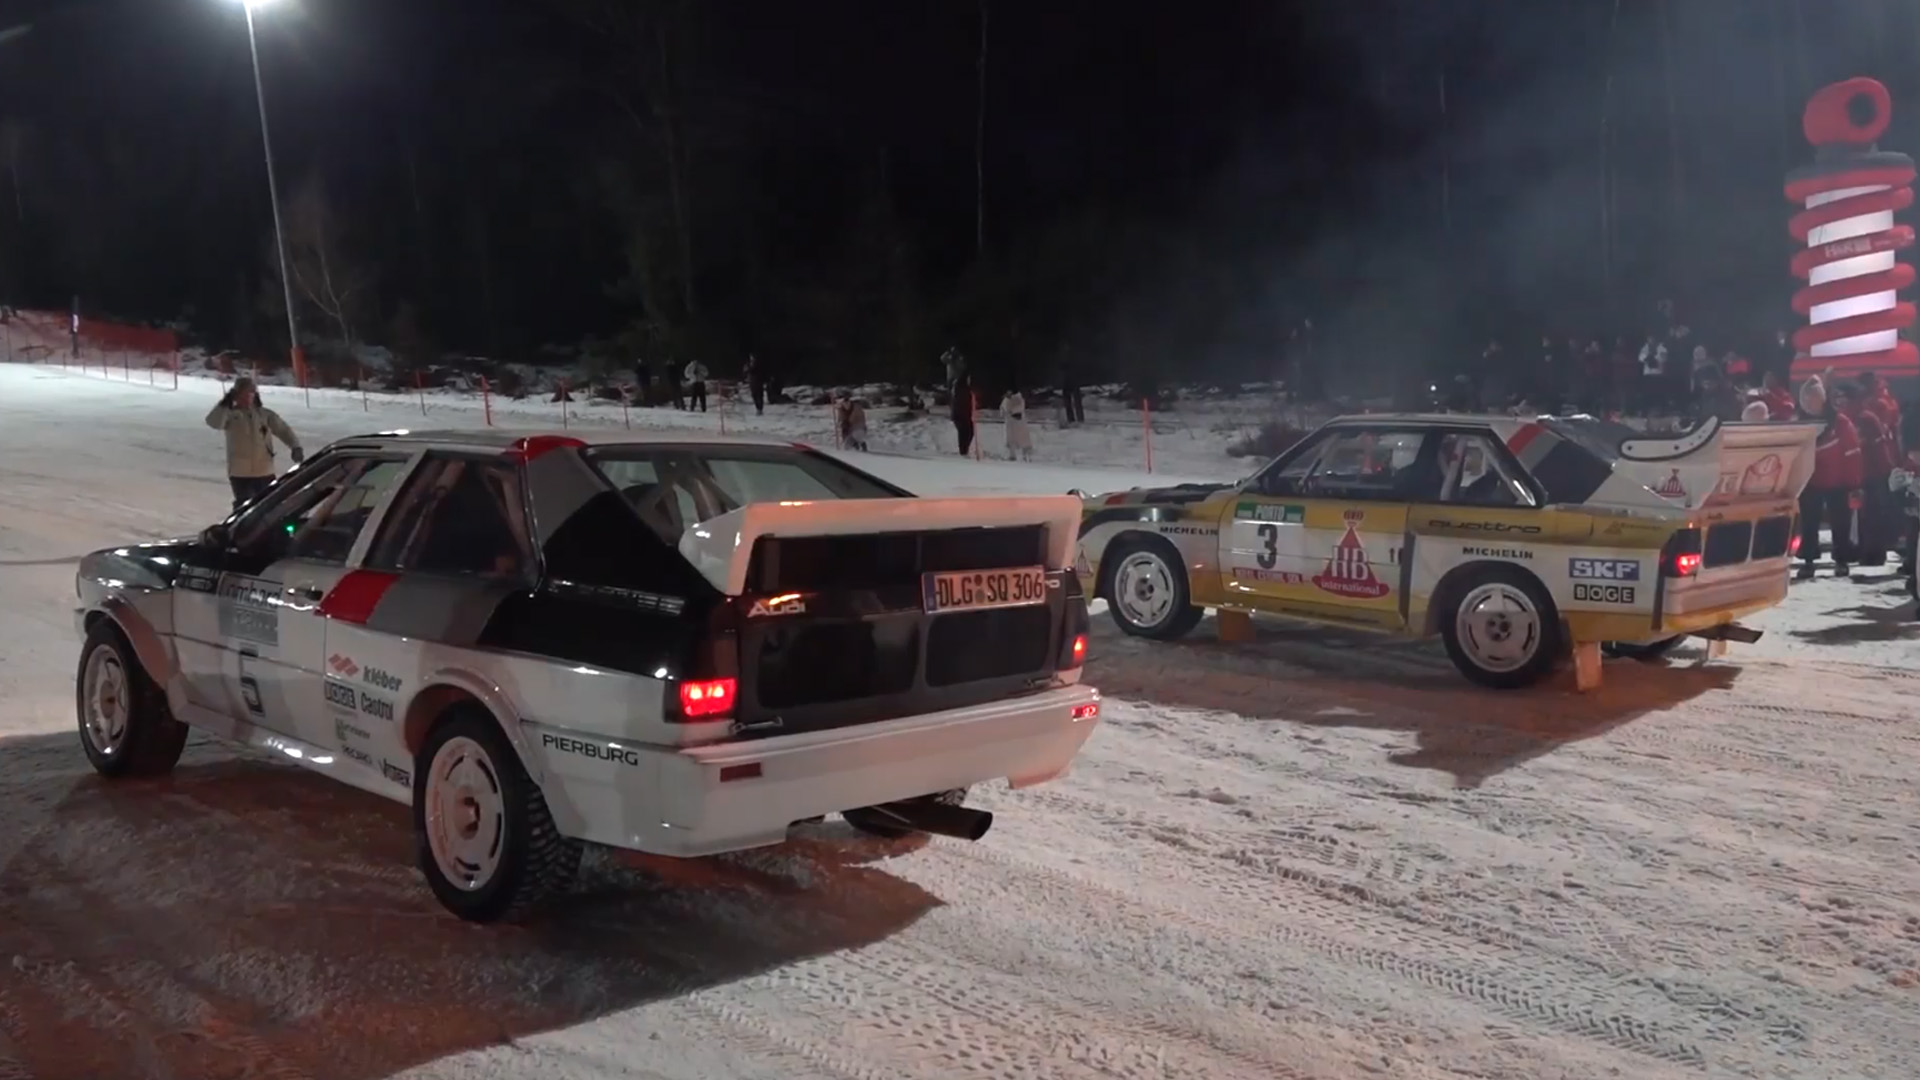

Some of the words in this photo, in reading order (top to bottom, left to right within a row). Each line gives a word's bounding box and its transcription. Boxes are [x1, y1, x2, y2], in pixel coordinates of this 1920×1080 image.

[1160, 526, 1219, 536] MICHELIN
[1429, 519, 1541, 534] quattro
[1257, 523, 1278, 570] 3
[1462, 547, 1534, 559] MICHELIN
[1331, 546, 1370, 581] HB
[1573, 560, 1637, 578] SKF
[937, 576, 973, 607] DLG
[987, 574, 1008, 602] SQ
[1012, 573, 1043, 600] 306
[1321, 580, 1380, 596] international
[1575, 585, 1634, 603] BOGE
[239, 645, 266, 717] 5
[542, 733, 639, 766] PIERBURG
